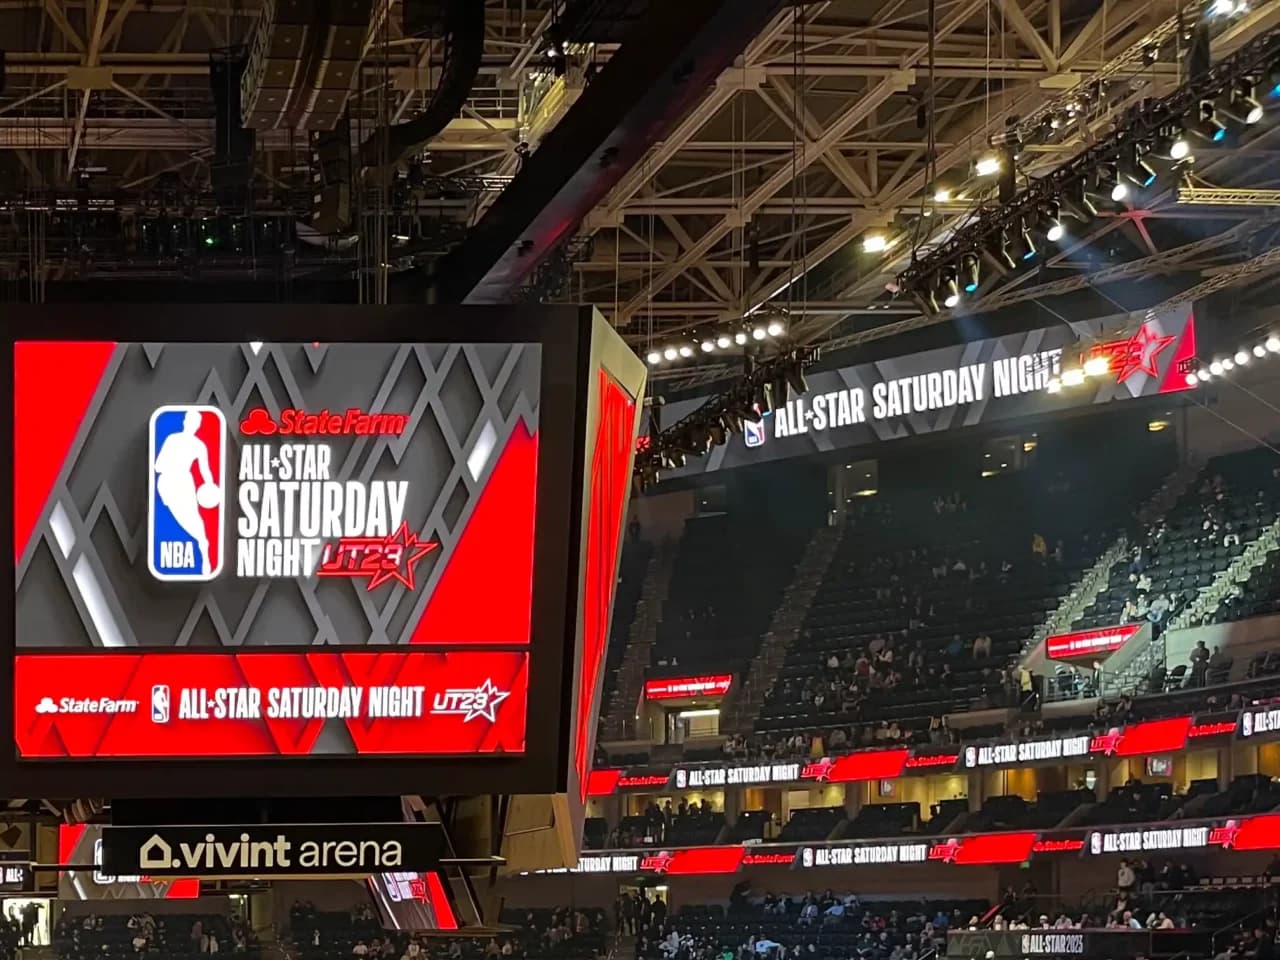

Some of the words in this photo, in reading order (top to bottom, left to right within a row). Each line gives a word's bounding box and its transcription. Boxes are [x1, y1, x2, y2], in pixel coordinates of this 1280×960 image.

[873, 364, 985, 419] SATURDAY
[993, 349, 1062, 396] NIGHT
[279, 408, 407, 435] StateFarm
[237, 481, 408, 538] SATURDAY
[160, 542, 195, 569] NBA
[236, 538, 321, 577] NIGHT
[59, 697, 137, 714] StateFarm
[267, 686, 363, 719] SATURDAY
[368, 686, 426, 718] NIGHT
[433, 692, 489, 712] UT23
[1019, 741, 1061, 761] SATURDAY
[1063, 736, 1088, 756] NIGHT
[727, 765, 771, 783] SATURDAY
[772, 763, 799, 781] NIGHT
[1143, 830, 1181, 849] SATURDAY
[1183, 827, 1208, 846] NIGHT
[300, 839, 402, 867] arena
[613, 856, 637, 871] NIGHT
[854, 846, 898, 863] SATURDAY
[899, 844, 926, 861] NIGHT
[1066, 935, 1084, 953] 2023
